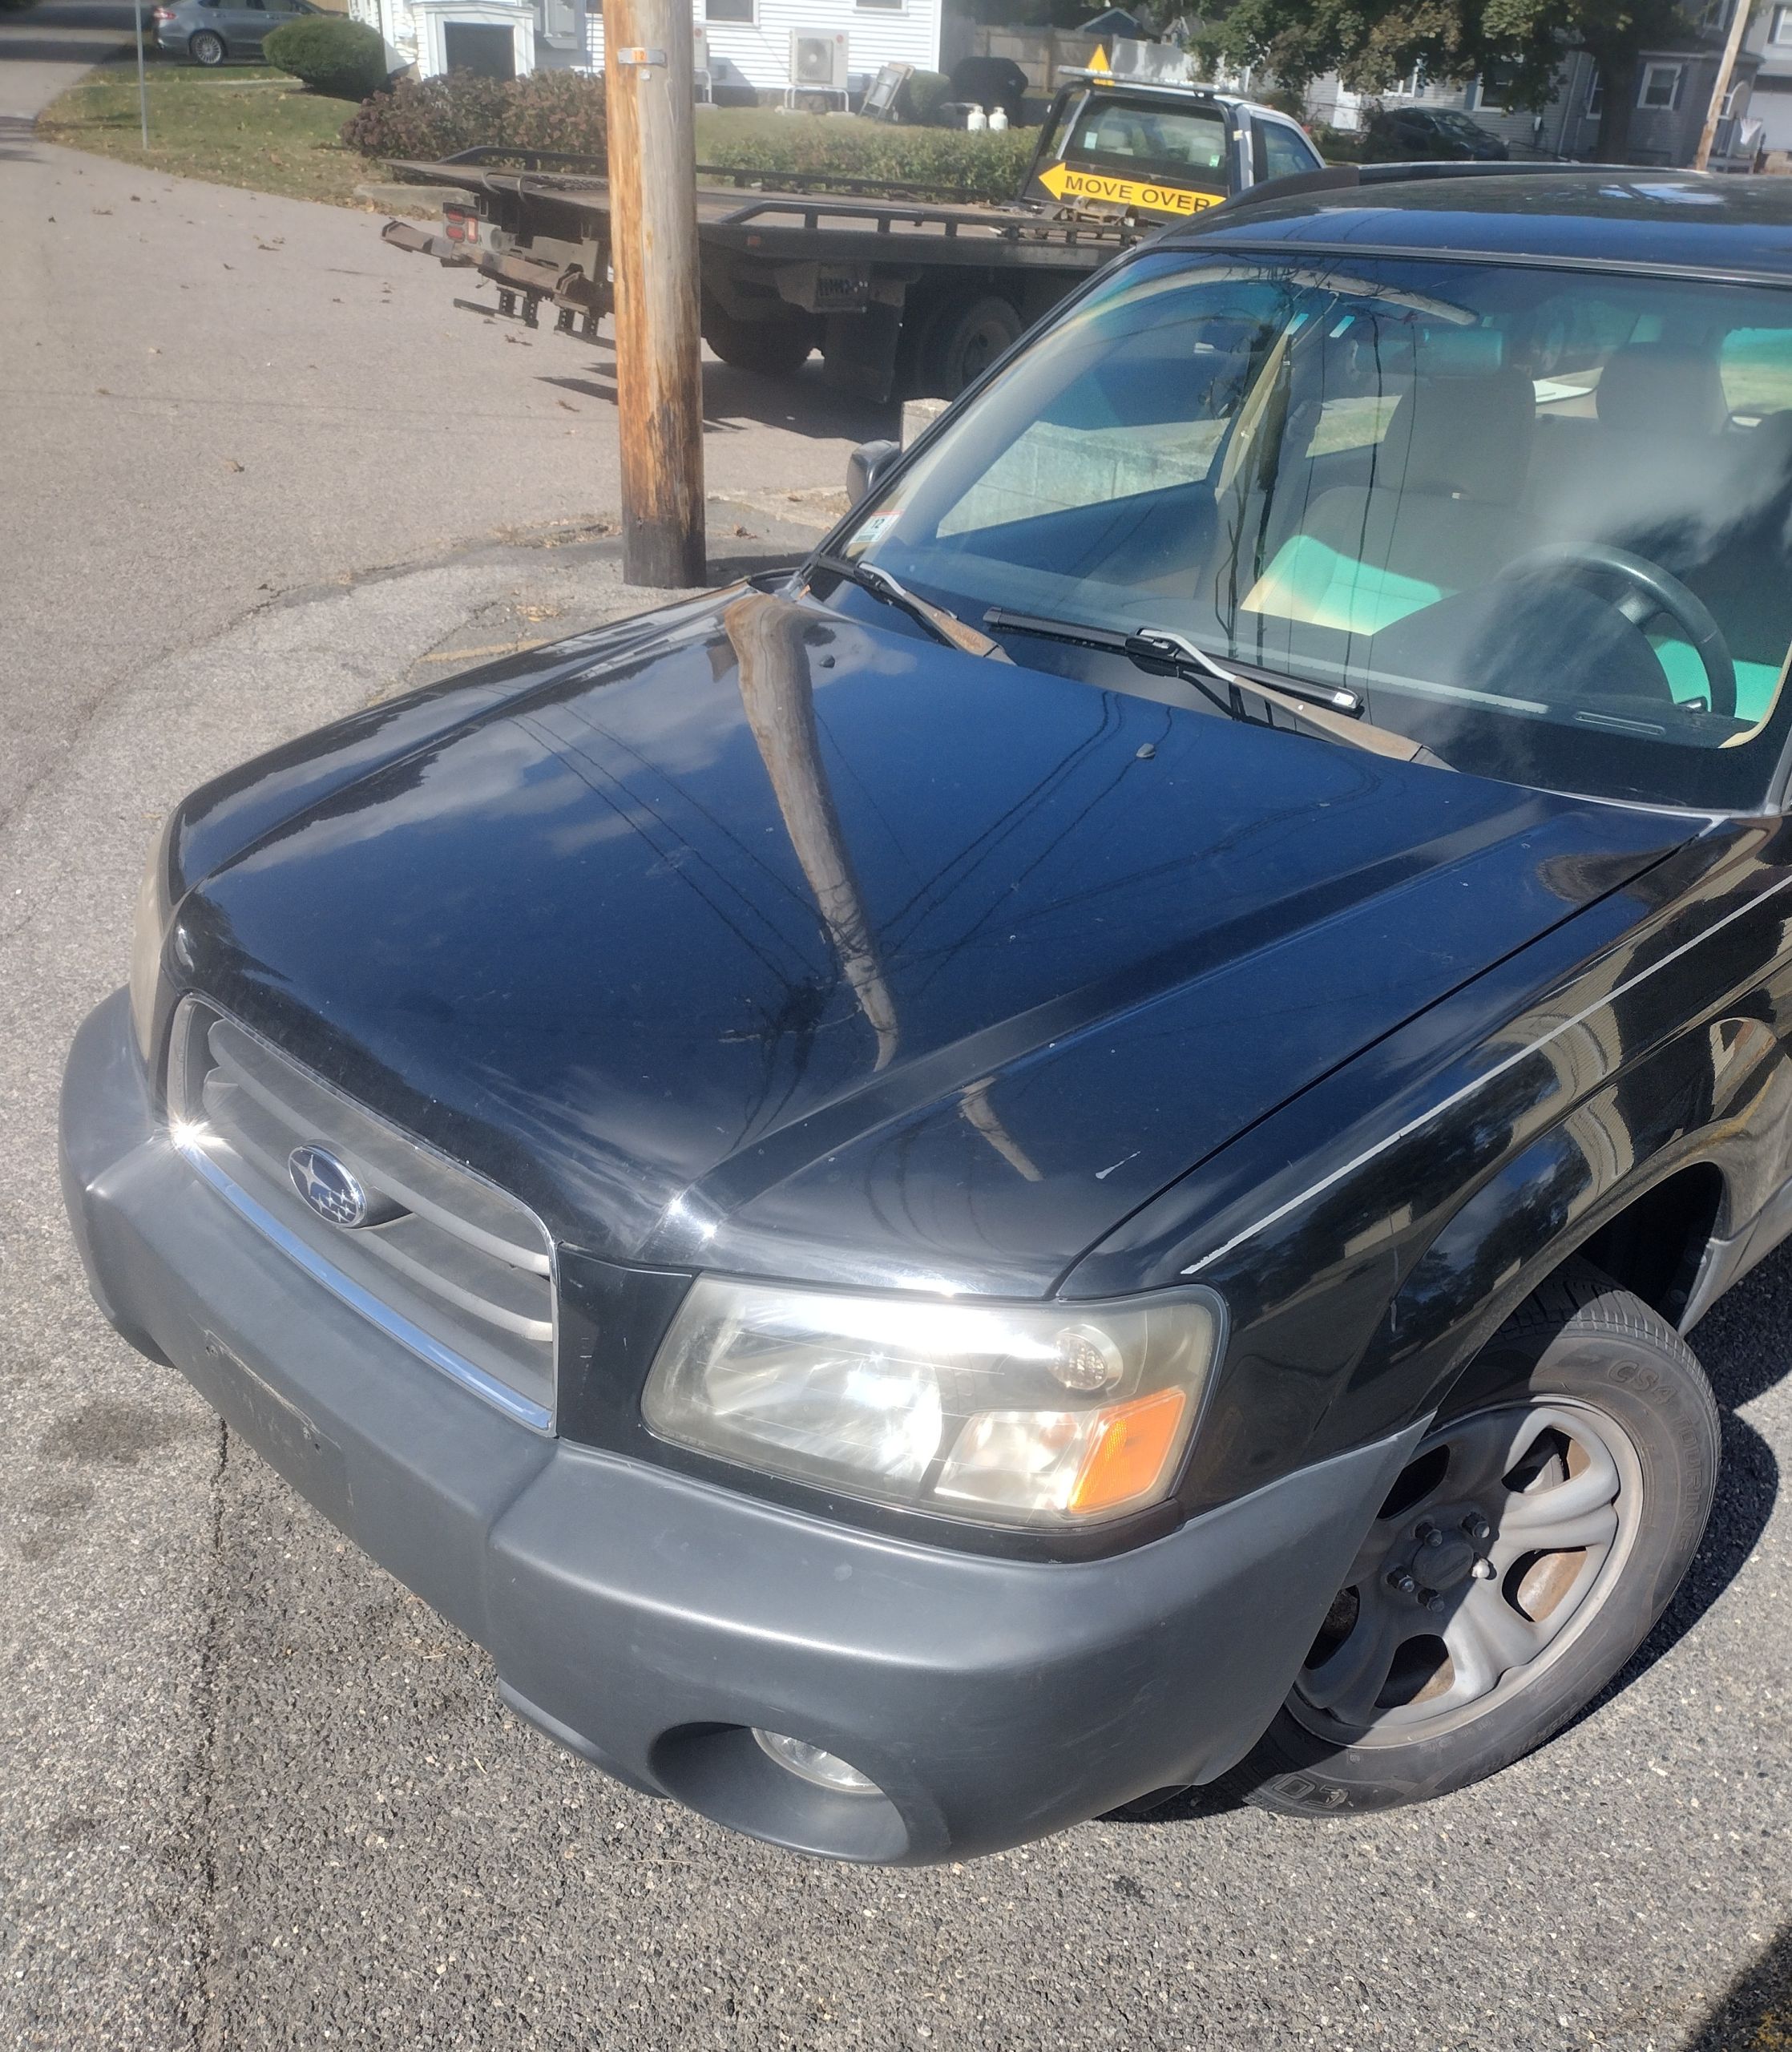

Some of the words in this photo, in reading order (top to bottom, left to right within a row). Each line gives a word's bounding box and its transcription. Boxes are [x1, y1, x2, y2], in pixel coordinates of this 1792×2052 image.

[1065, 176, 1134, 200] MOVE
[1141, 188, 1210, 212] OVER
[871, 518, 885, 529] 12
